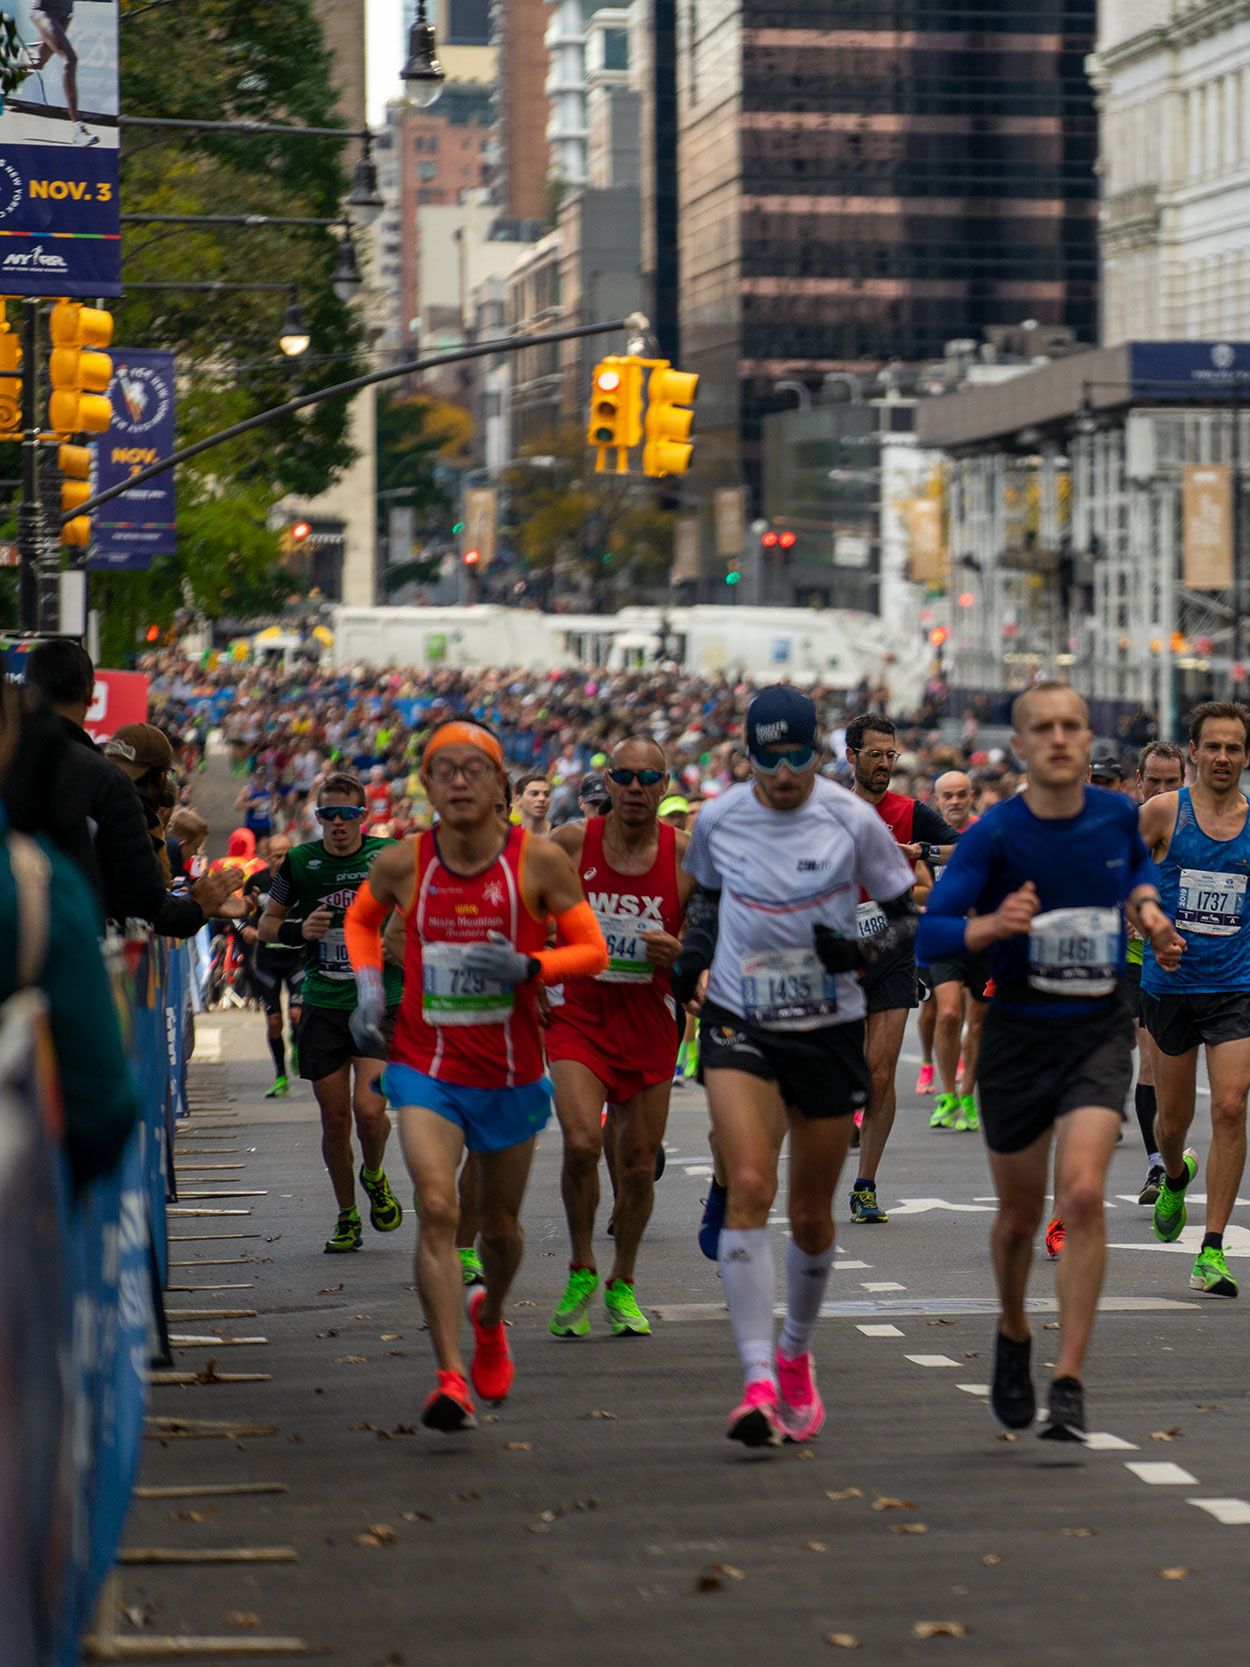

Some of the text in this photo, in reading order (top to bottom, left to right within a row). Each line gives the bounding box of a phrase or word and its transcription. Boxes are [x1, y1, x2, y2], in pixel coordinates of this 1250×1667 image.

[29, 180, 113, 202] NOV. 3
[112, 448, 161, 464] NOV.
[588, 892, 664, 919] WSX
[1179, 888, 1188, 909] 2019
[1197, 890, 1229, 912] 1737
[858, 915, 888, 936] 1488
[449, 968, 486, 994] 729
[768, 975, 811, 1002] 1435
